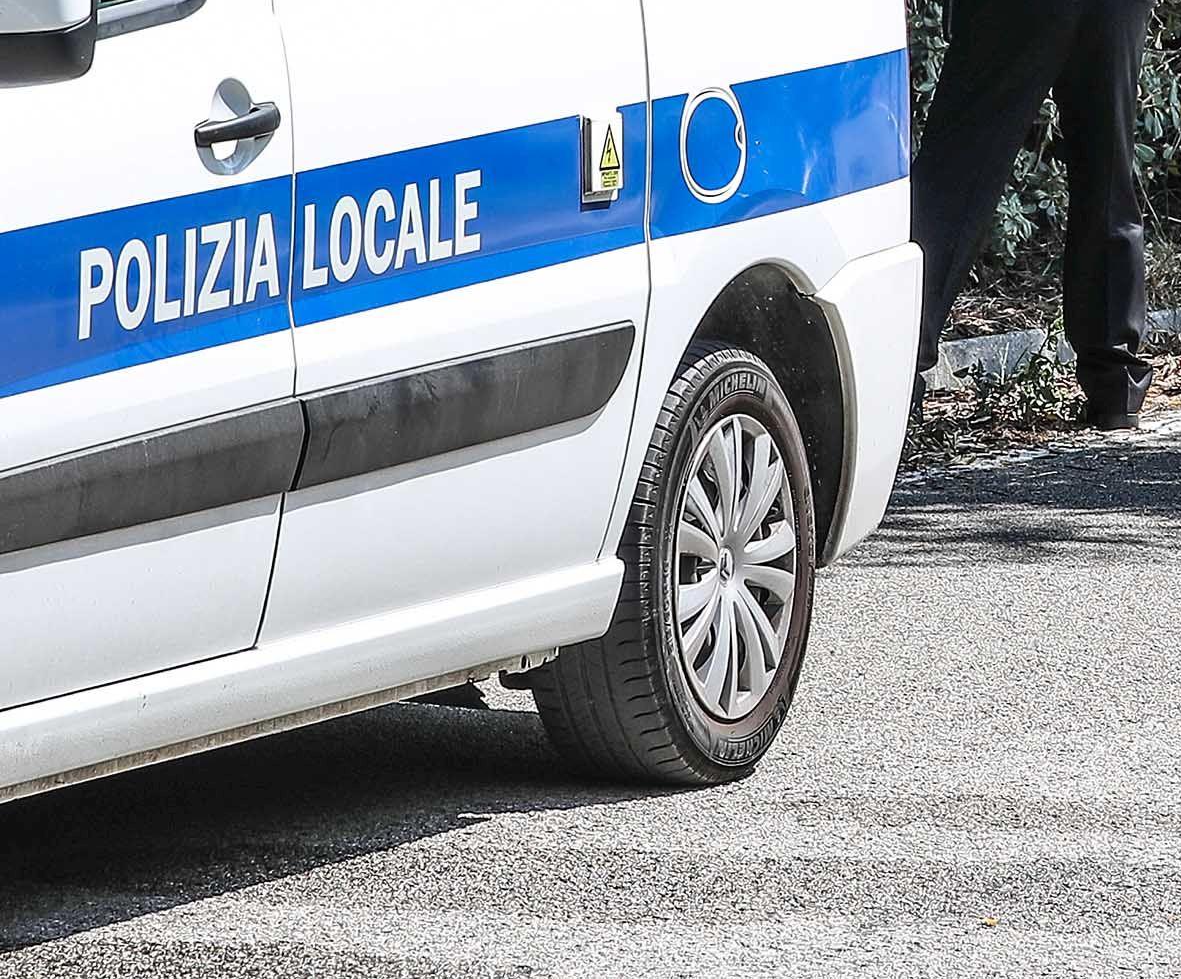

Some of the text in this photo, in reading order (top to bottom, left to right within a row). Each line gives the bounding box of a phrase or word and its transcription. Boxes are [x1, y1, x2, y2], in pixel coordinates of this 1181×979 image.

[78, 169, 481, 341] POLIZIA LOCALE
[709, 372, 767, 410] MICHELIN
